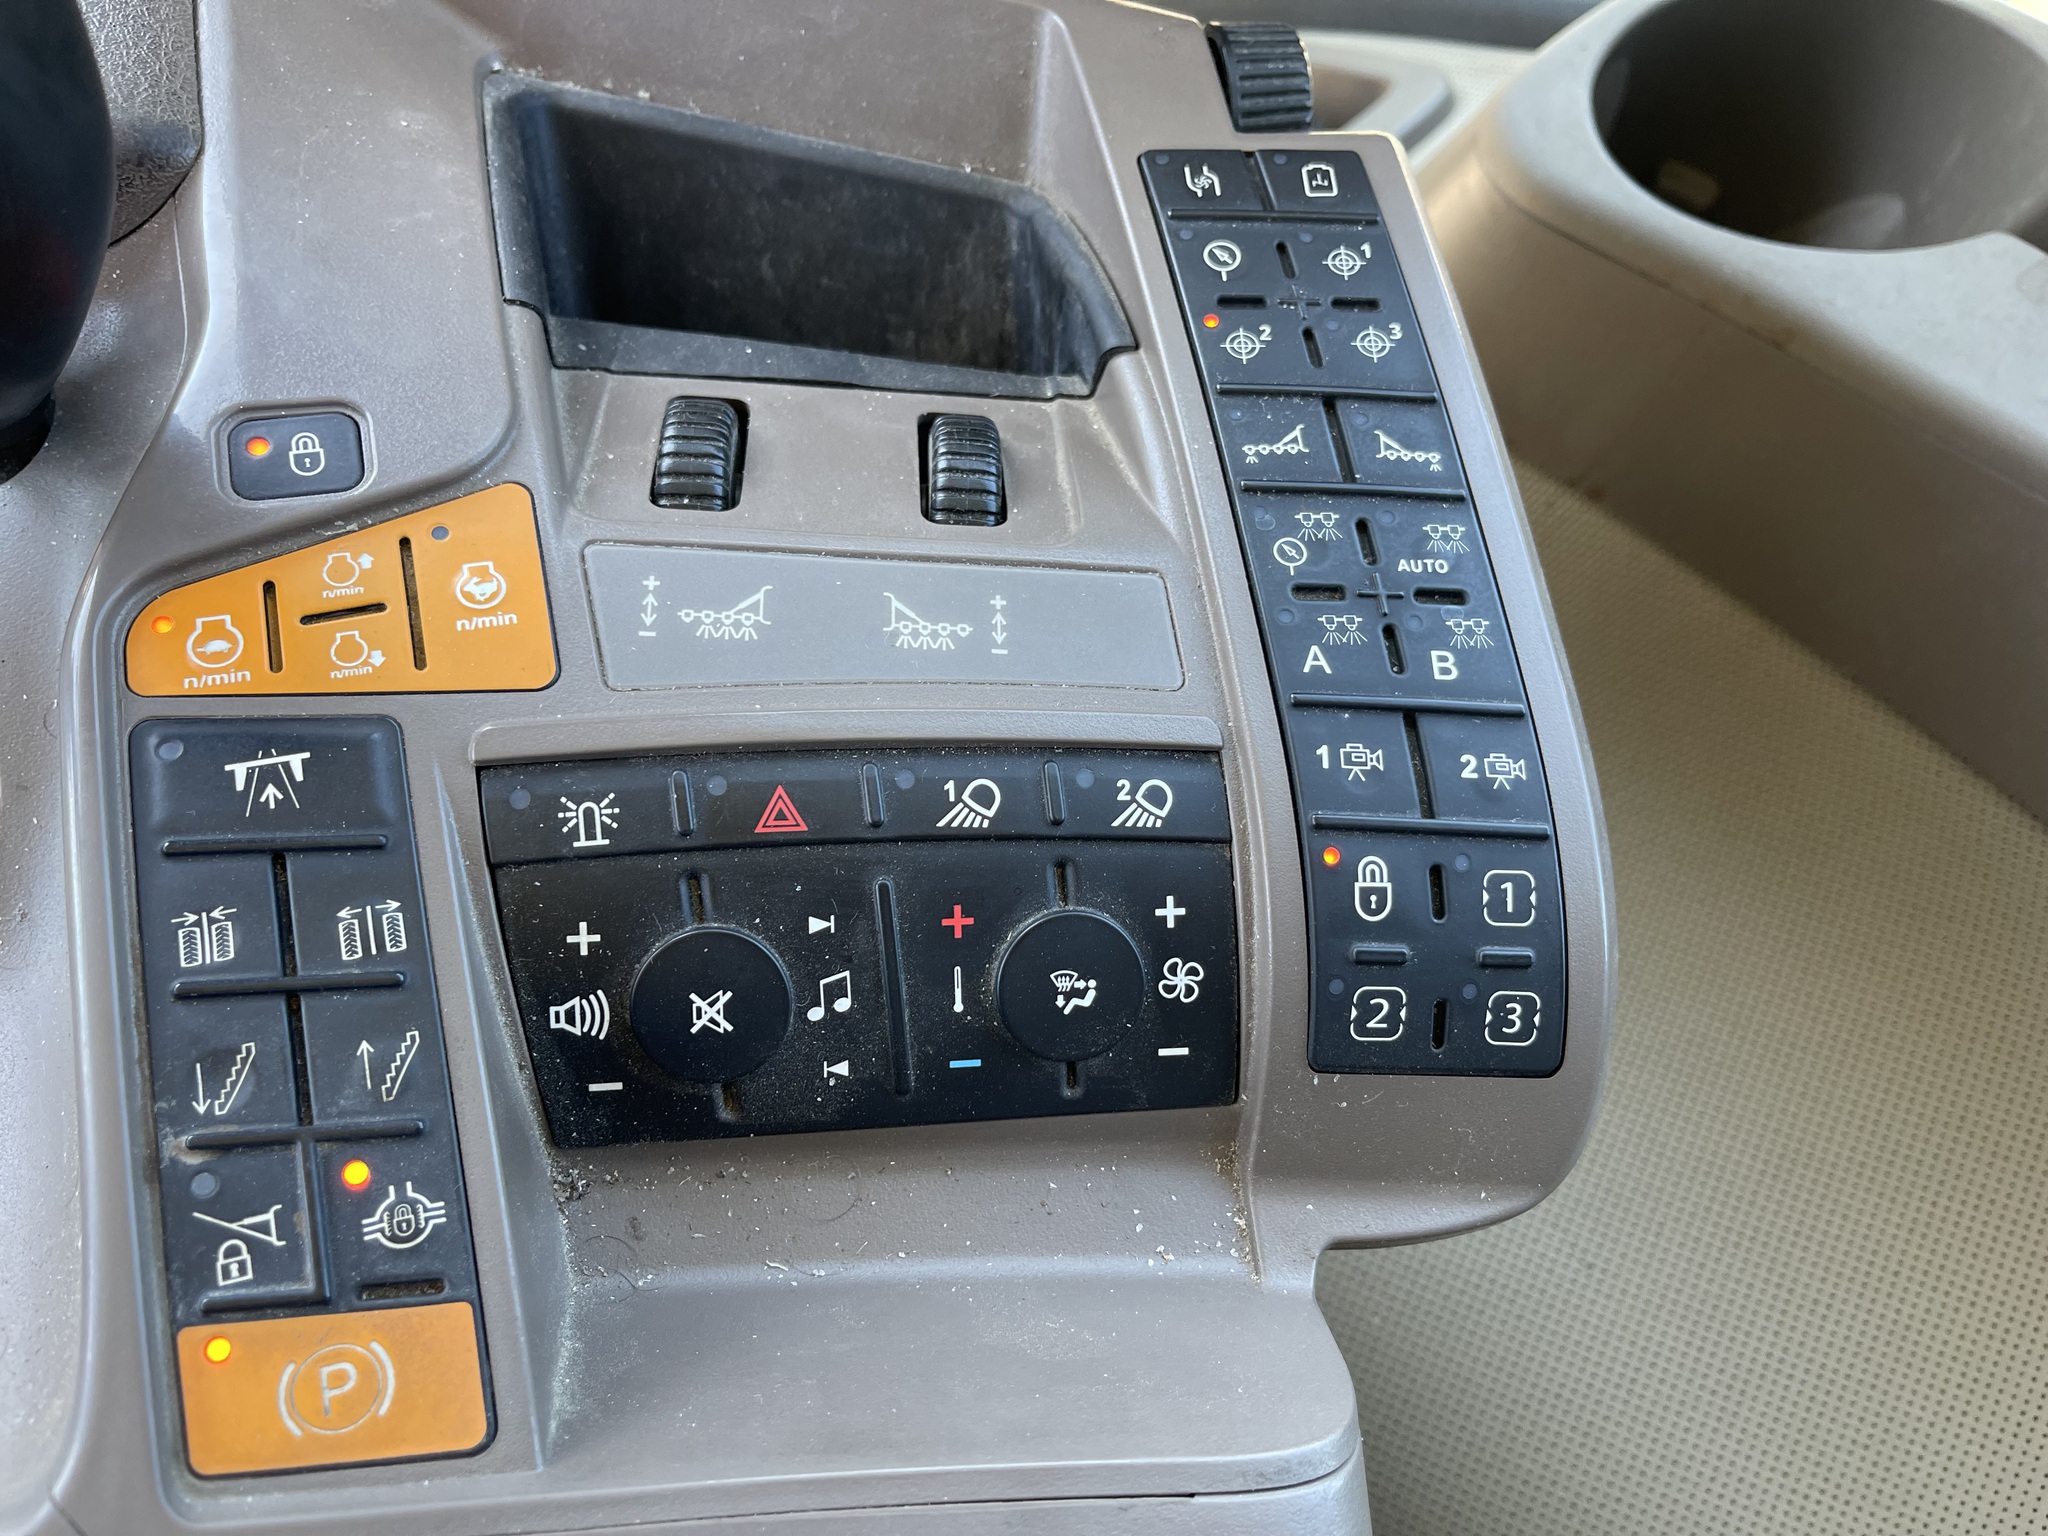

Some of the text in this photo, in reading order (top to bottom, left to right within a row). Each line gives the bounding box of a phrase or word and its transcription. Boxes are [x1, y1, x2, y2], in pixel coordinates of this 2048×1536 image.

[1360, 242, 1372, 259] 1
[1258, 324, 1273, 341] 2
[1388, 322, 1403, 340] 3
[1397, 558, 1449, 574] AUTO
[321, 584, 365, 599] n/min
[456, 611, 518, 631] n/min
[1302, 645, 1332, 674] A
[1430, 650, 1459, 680] B
[183, 668, 251, 689] n/min
[330, 664, 373, 679] n/min
[1316, 745, 1330, 769] 1
[1459, 754, 1479, 779] 2
[943, 779, 955, 802] 1
[1116, 779, 1131, 801] 2
[1500, 881, 1514, 913] 1
[1366, 998, 1390, 1028] 2
[1501, 1003, 1522, 1033] 3
[319, 1362, 358, 1416] P
